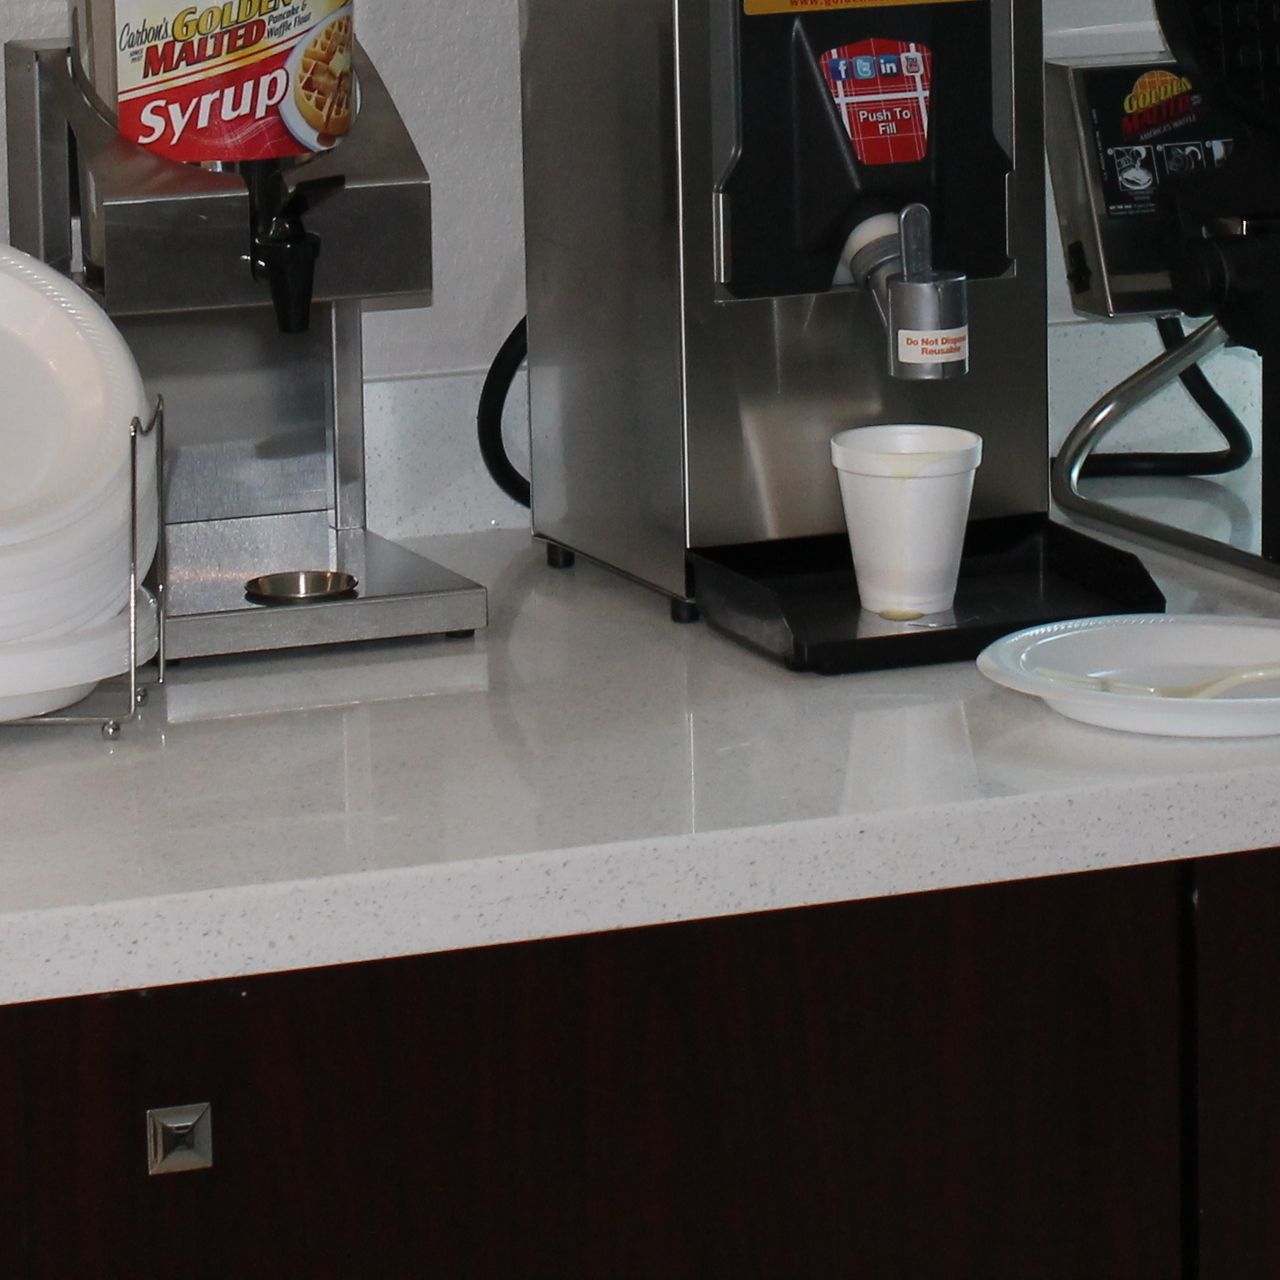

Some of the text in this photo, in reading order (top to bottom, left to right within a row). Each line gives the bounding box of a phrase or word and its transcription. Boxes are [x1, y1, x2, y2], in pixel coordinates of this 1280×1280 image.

[118, 17, 170, 52] Carbon's
[266, 21, 293, 39] Waffle
[142, 18, 267, 80] MALTED
[137, 67, 290, 146] Syrup
[859, 107, 912, 123] Push To
[878, 122, 897, 135] Fill
[906, 337, 919, 346] Do
[921, 337, 939, 346] Not
